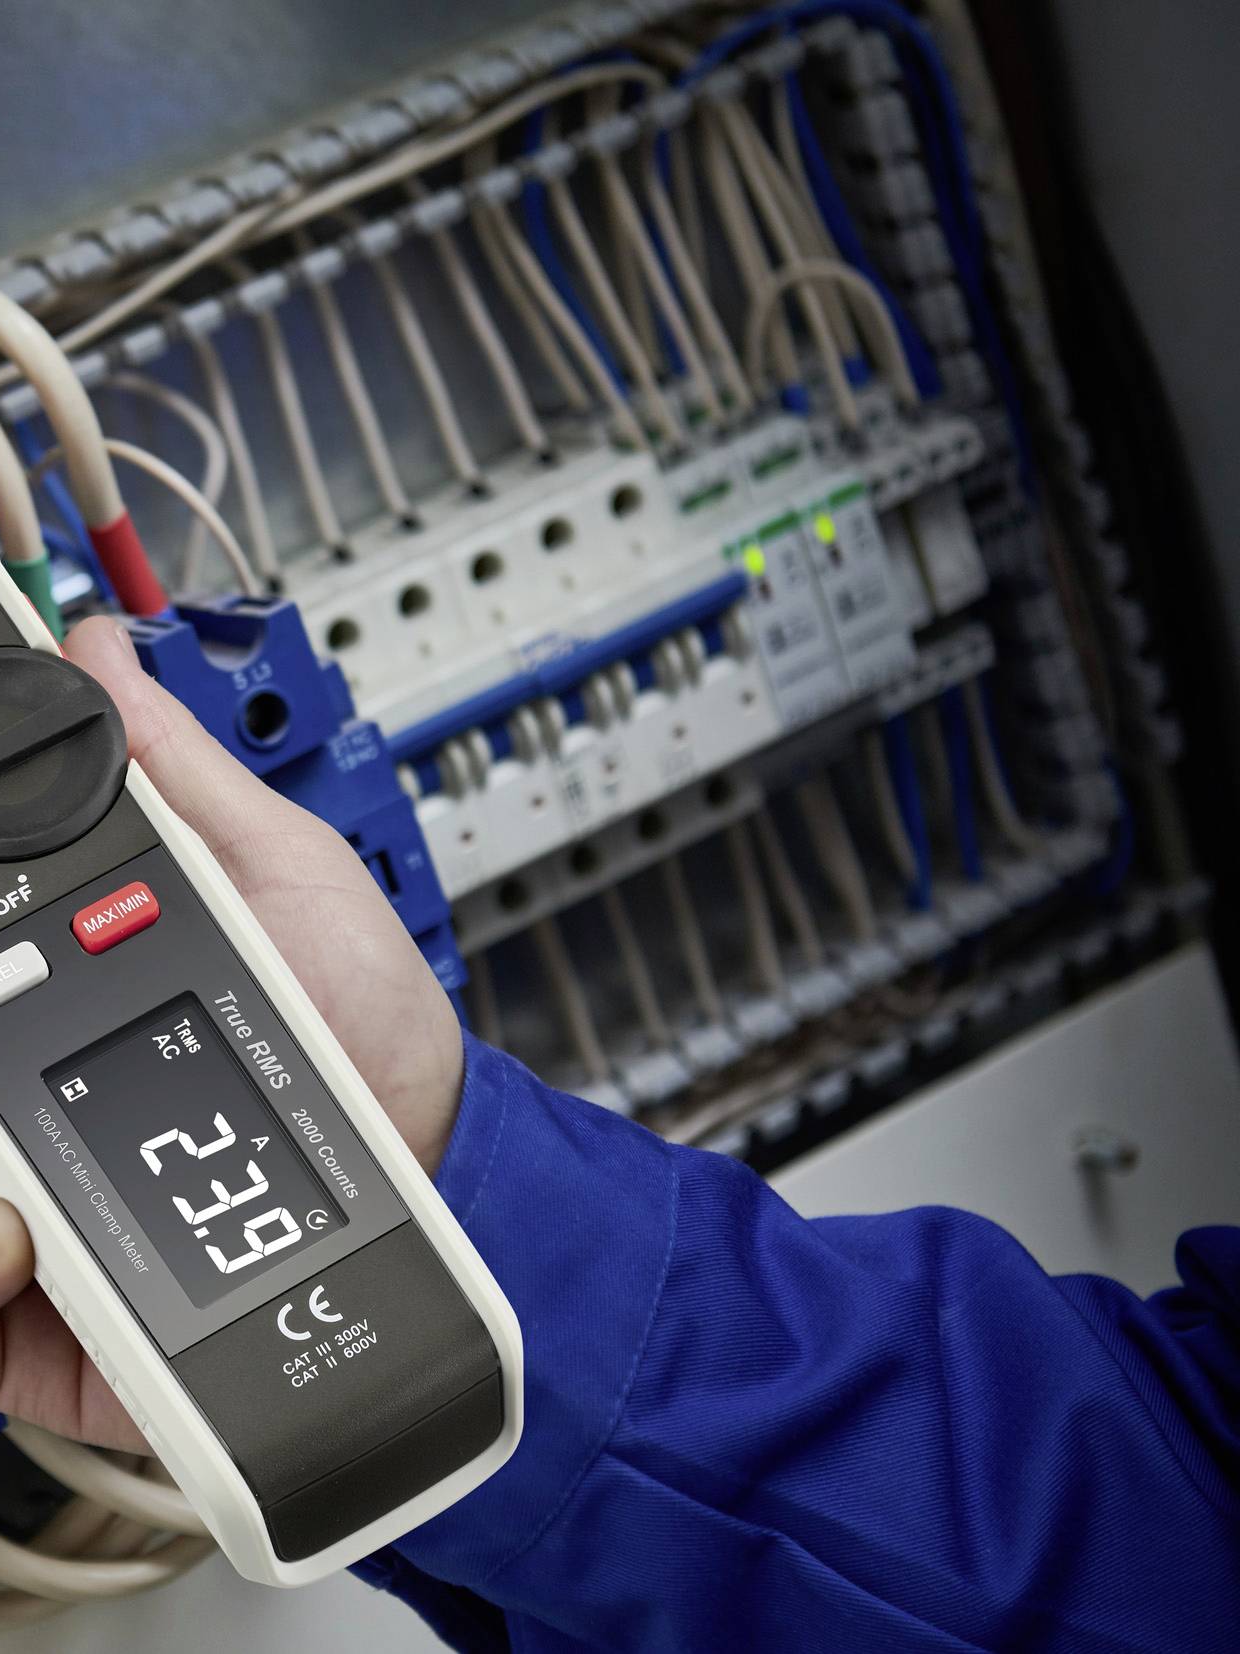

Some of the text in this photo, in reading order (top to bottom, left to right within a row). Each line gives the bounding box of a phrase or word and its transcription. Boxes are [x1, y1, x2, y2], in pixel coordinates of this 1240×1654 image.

[152, 1034, 180, 1060] AC
[214, 990, 292, 1090] True RMS
[250, 1135, 270, 1152] A
[291, 1108, 359, 1199] 2000 Counts
[34, 1107, 149, 1273] 100A AC Mini Clamp Meter
[139, 1111, 302, 1274] 23.9
[277, 1285, 344, 1341] CE
[282, 1318, 368, 1375] CAT III 300V
[291, 1331, 377, 1388] CAT II 600V
